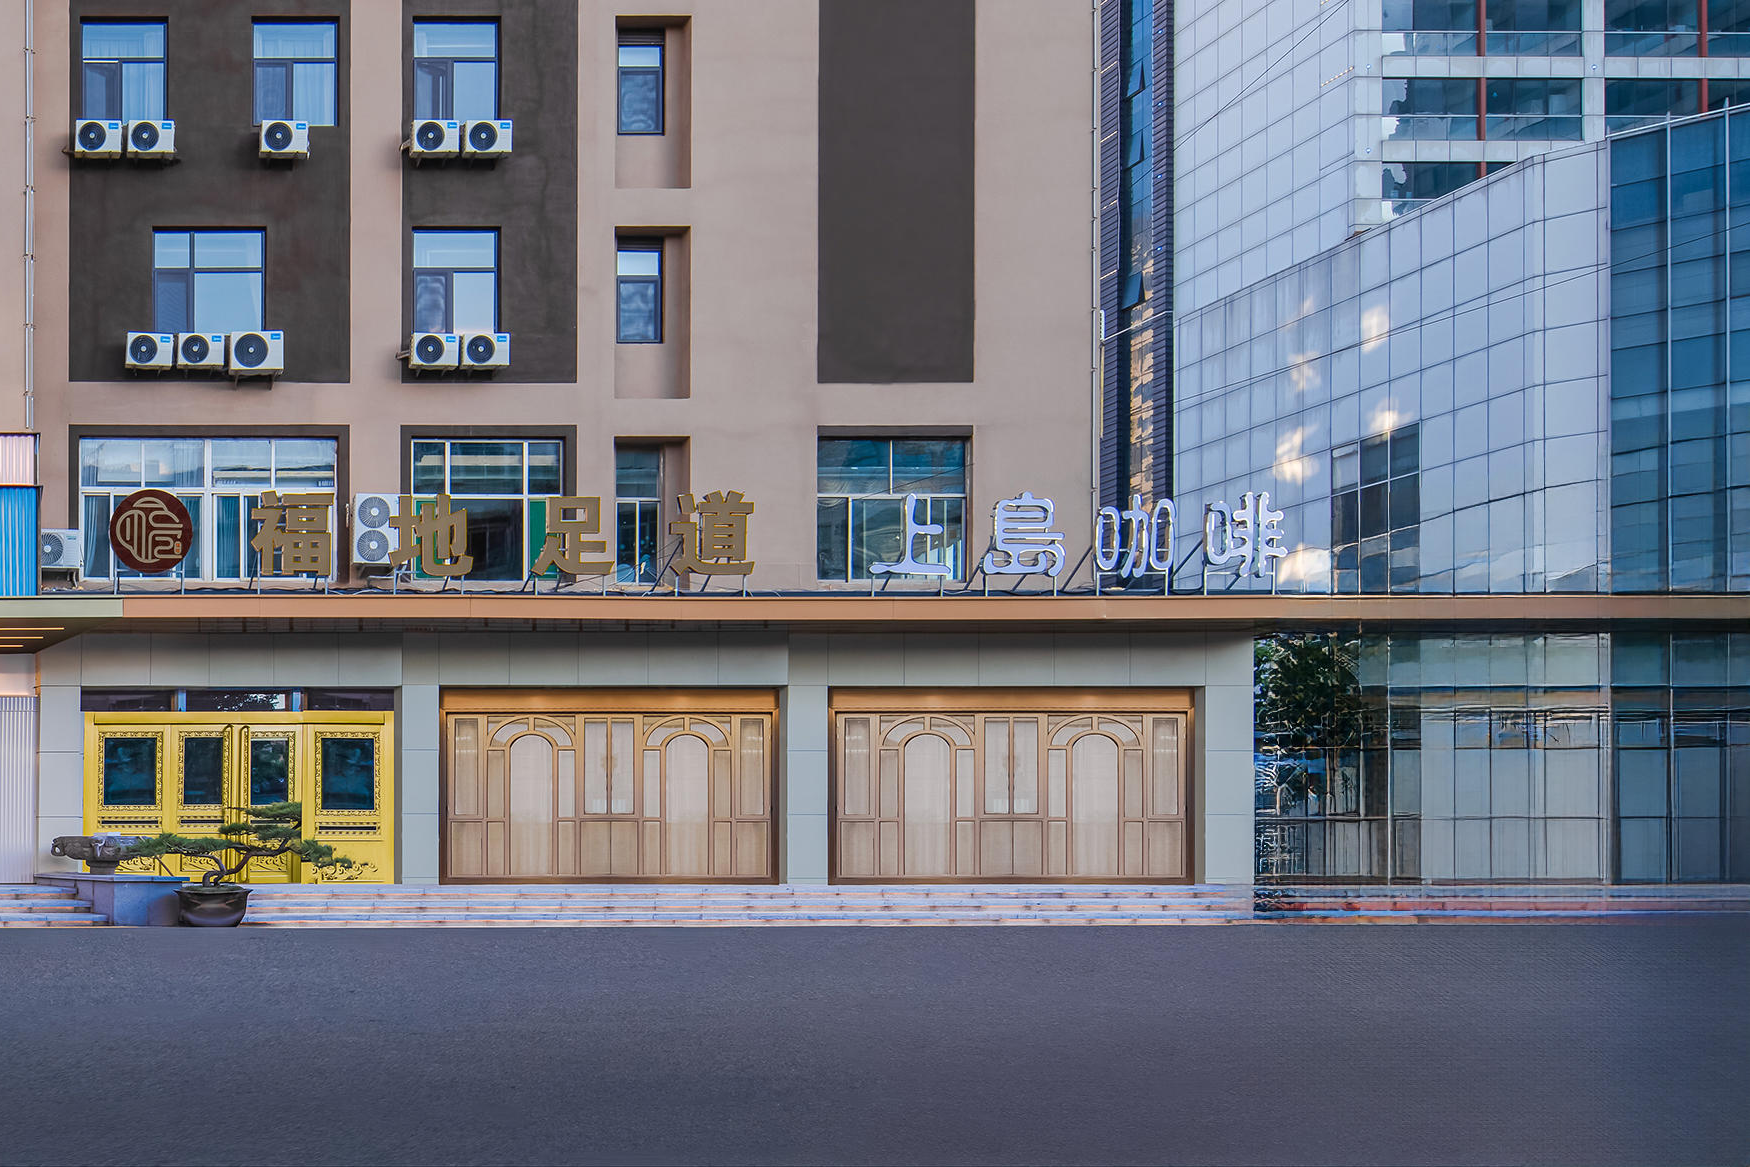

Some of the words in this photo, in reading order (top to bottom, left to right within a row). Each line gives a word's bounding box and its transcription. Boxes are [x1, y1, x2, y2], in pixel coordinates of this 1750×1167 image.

[250, 490, 755, 577] 福地足道
[869, 491, 1289, 578] 上島咖啡
